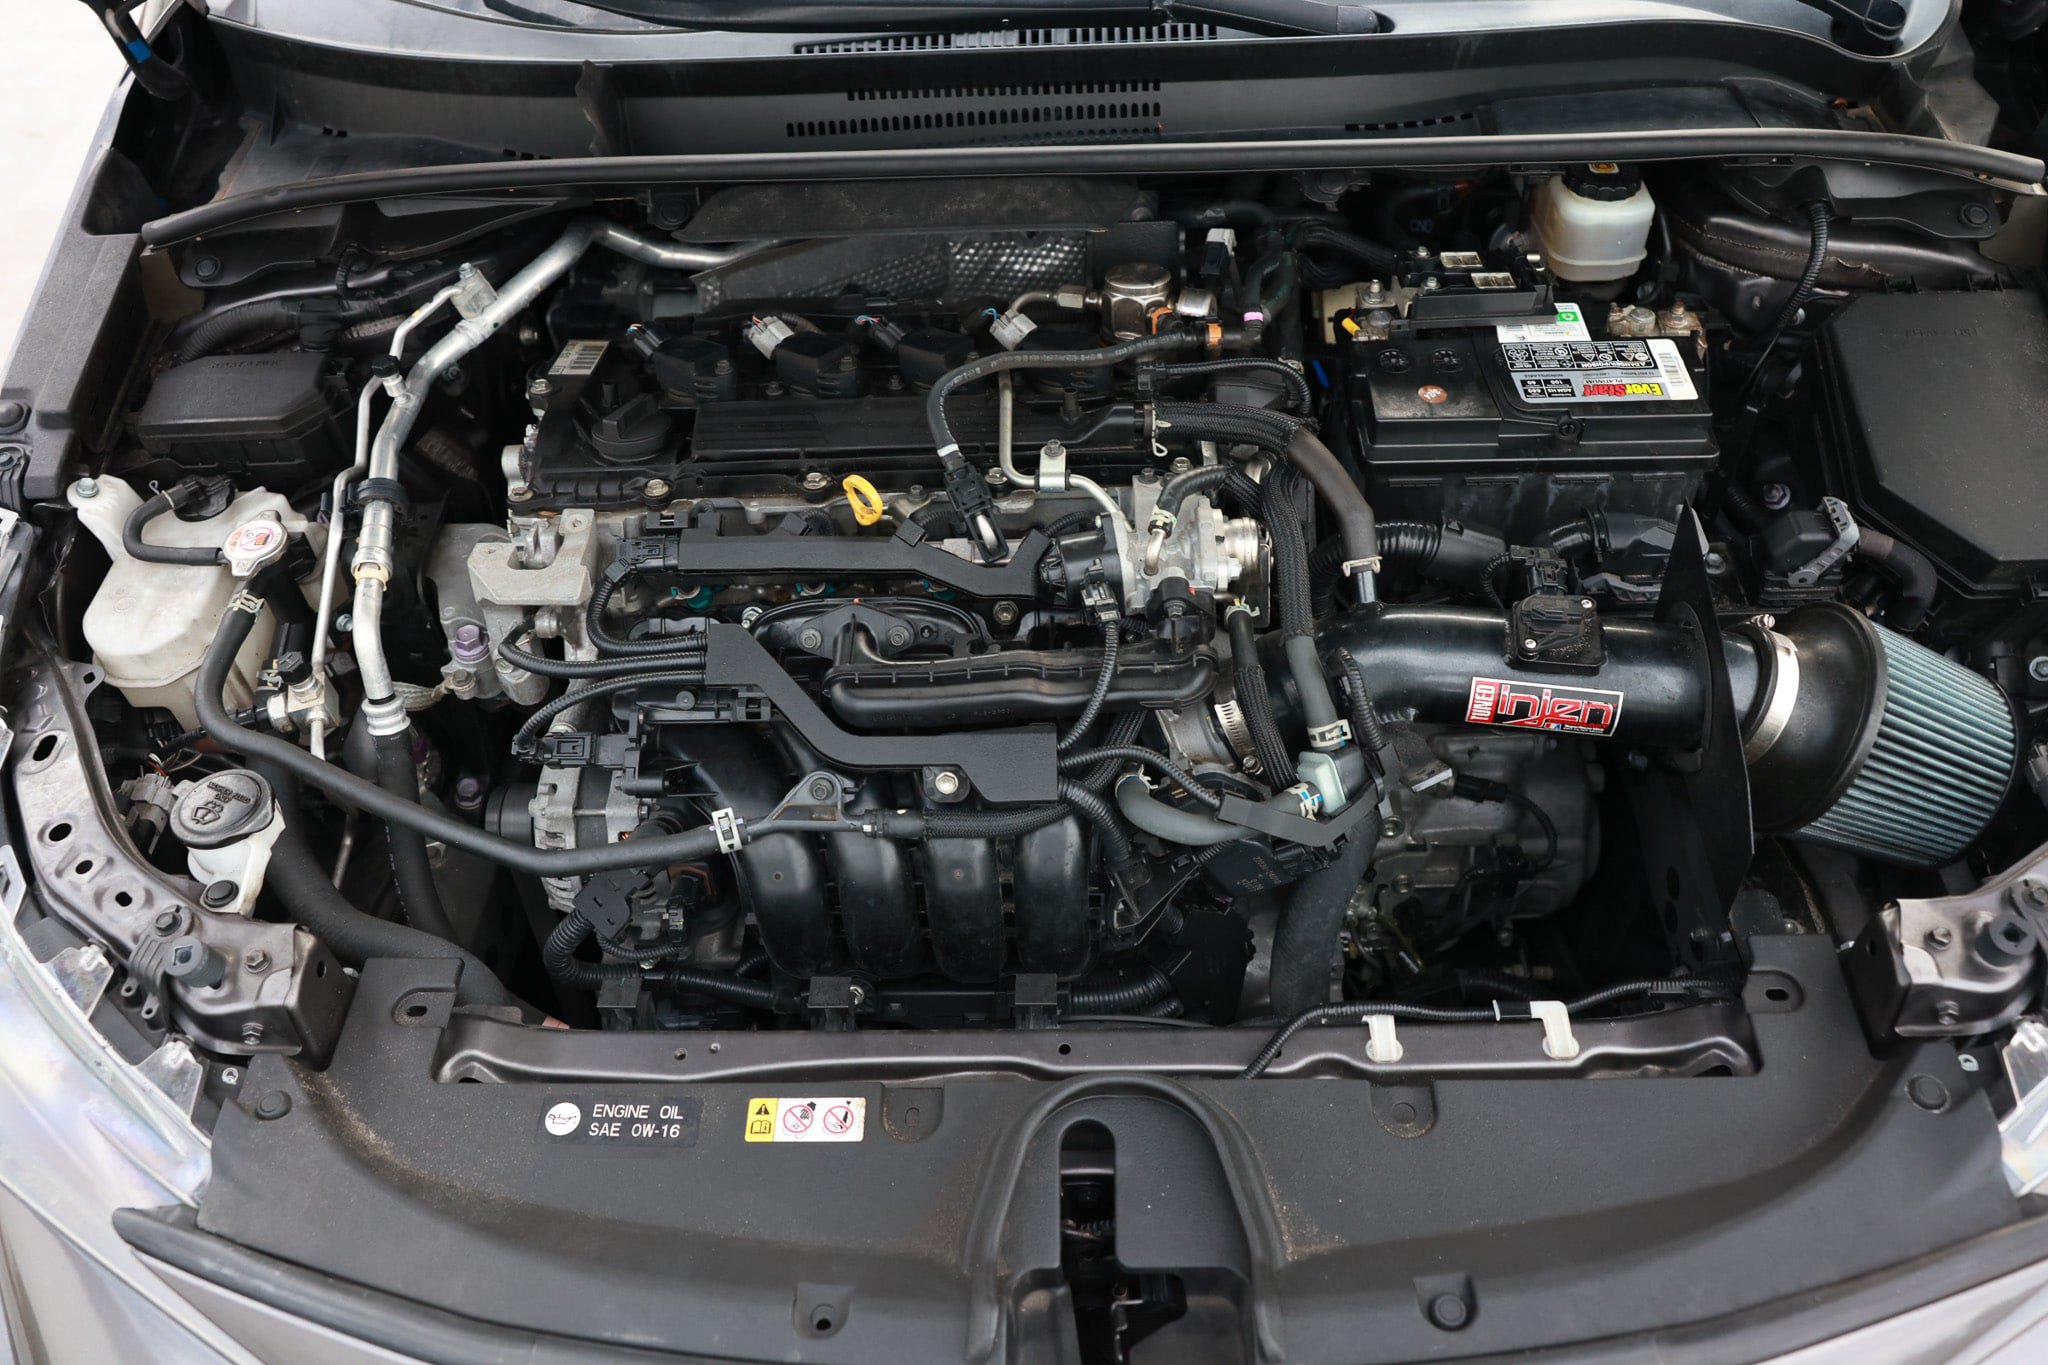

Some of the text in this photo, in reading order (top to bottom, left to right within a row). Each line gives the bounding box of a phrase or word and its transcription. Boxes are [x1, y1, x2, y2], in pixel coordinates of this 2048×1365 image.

[1583, 383, 1664, 397] EverStart
[1470, 684, 1496, 721] TUNED
[1497, 684, 1614, 728] injen
[592, 1103, 684, 1120] ENGINE OIL
[588, 1122, 681, 1138] SAE 0W-16
